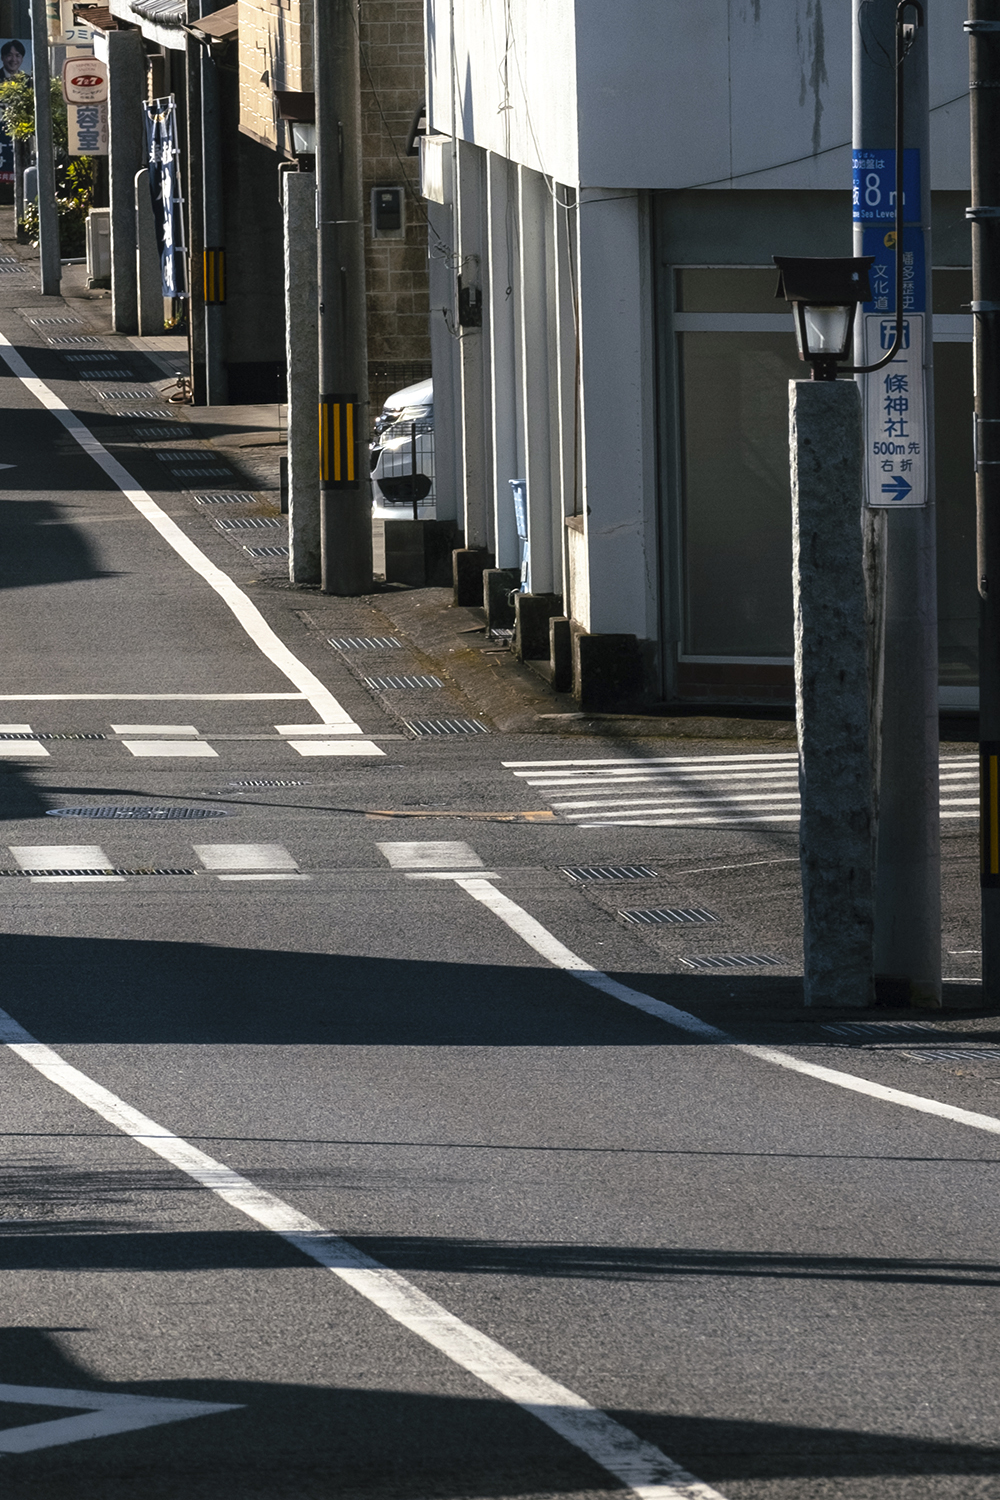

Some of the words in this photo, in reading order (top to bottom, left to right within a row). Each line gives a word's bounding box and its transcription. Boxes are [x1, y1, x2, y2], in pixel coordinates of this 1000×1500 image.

[76, 77, 98, 85] 727
[76, 105, 100, 151] 容室
[873, 264, 889, 310] 文化道
[883, 359, 910, 438] 一條神社
[881, 459, 913, 472] 右折
